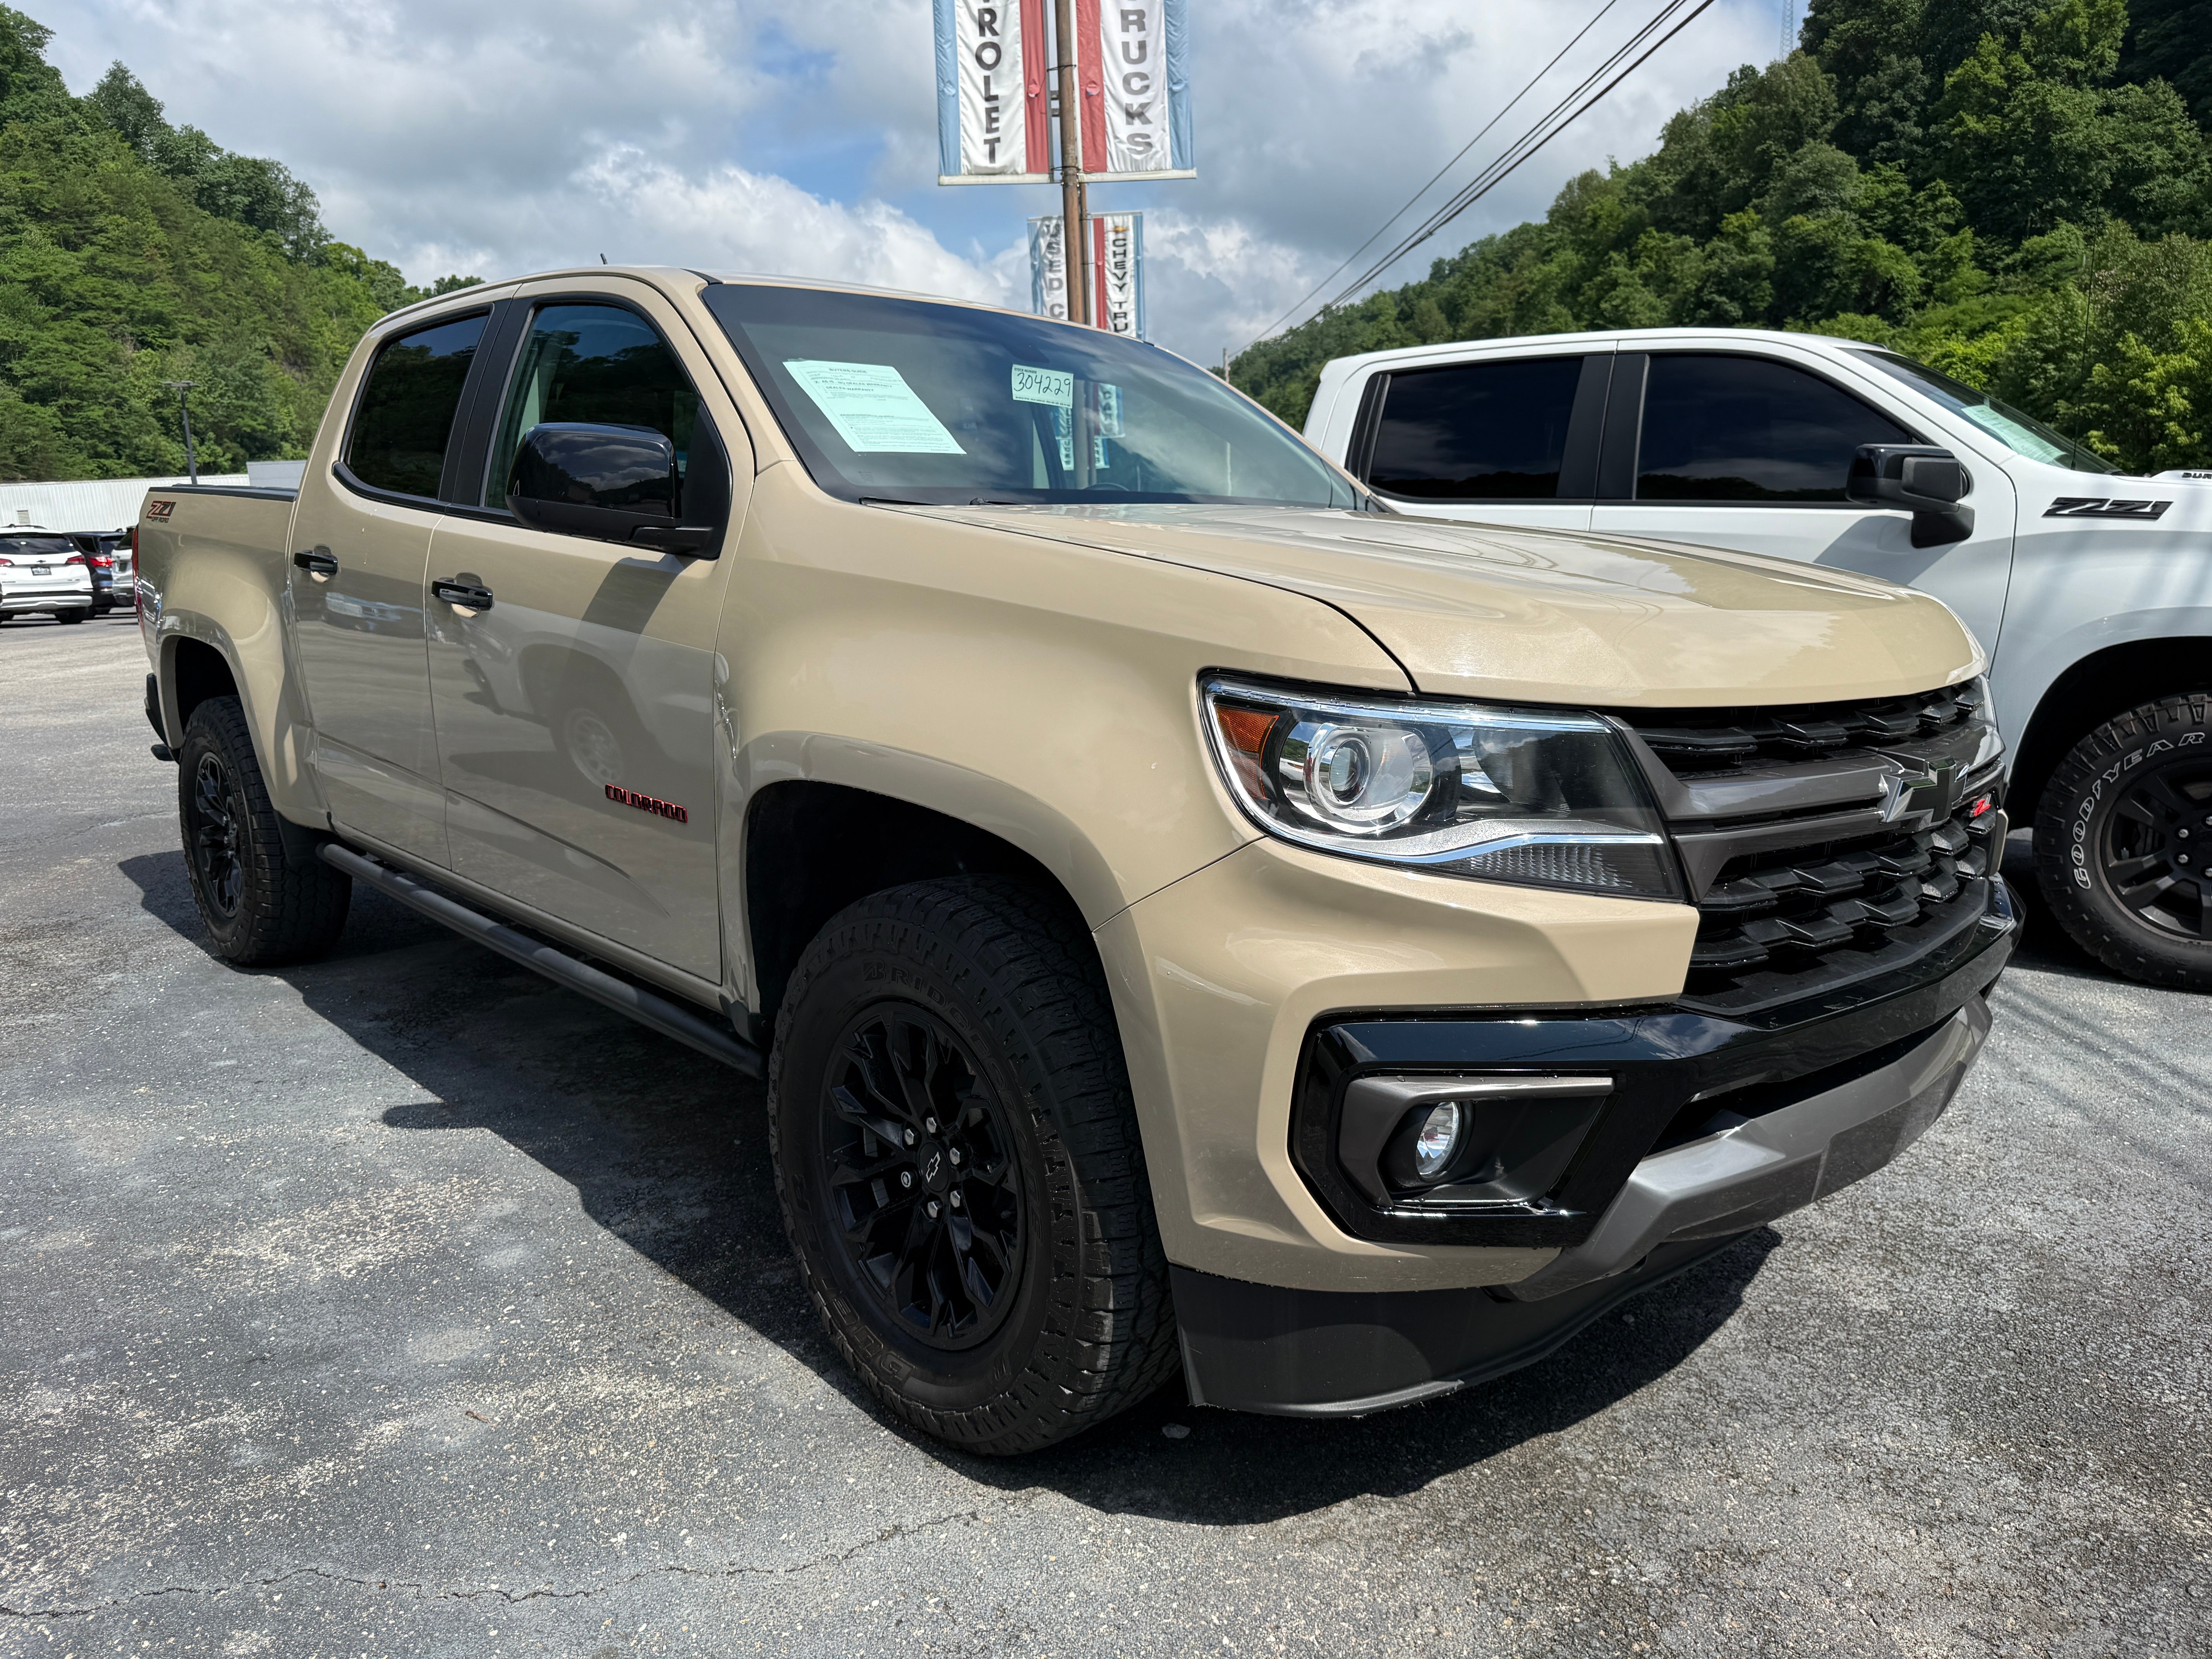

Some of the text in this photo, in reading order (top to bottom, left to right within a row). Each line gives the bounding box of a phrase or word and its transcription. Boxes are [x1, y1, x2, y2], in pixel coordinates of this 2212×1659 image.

[975, 0, 1001, 164] ROLET
[1120, 0, 1153, 155] RUCKS
[1046, 223, 1064, 318] USED C
[1113, 238, 1128, 332] CHEVY TRU
[1014, 373, 1070, 397] 304229
[146, 500, 176, 519] Z71
[2041, 497, 2174, 521] Z71
[605, 783, 688, 823] COLORADO
[2071, 732, 2205, 890] GOODYEAR
[863, 958, 1043, 1241] BRIDGESTONE
